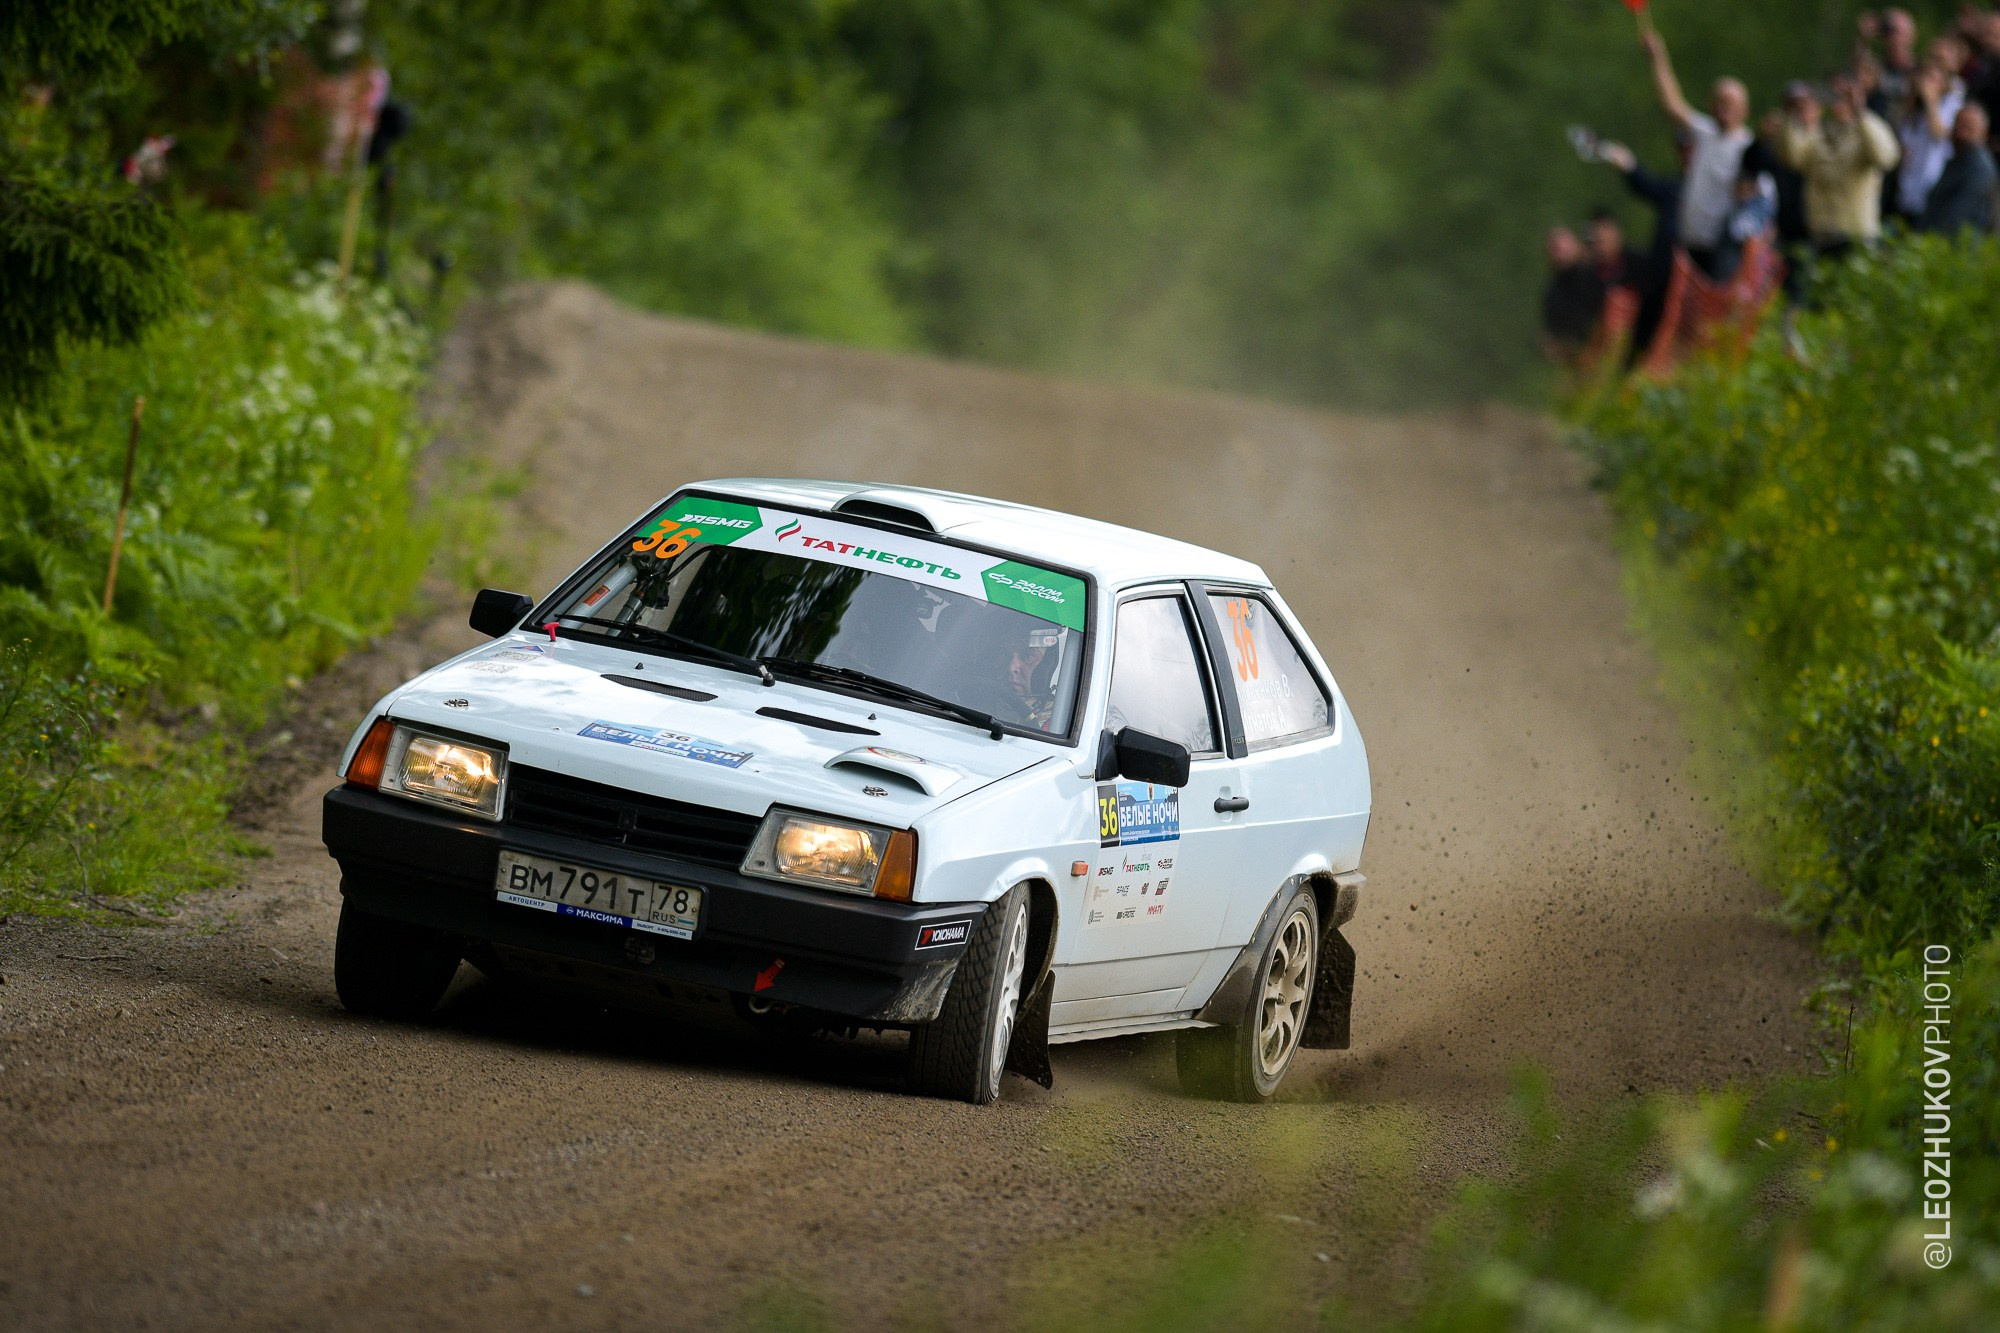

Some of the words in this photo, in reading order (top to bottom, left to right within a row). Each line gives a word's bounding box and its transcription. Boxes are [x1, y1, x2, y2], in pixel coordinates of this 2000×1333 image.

[632, 519, 702, 559] 36
[801, 536, 962, 580] ТАТНЕФТЬ
[1227, 597, 1259, 682] 36
[591, 725, 673, 747] БЕЛЫЕ
[674, 742, 743, 762] НОЧИ
[660, 731, 691, 743] 36
[1100, 796, 1118, 837] 36
[1120, 804, 1151, 828] БЕЛЫЕ
[1152, 801, 1179, 824] НОЧИ
[508, 895, 546, 908] АВТОЦЕНТР
[658, 885, 690, 915] 78
[576, 908, 624, 926] МАКСИМА
[652, 911, 677, 925] RUS
[931, 926, 965, 943] YOKOHAMA
